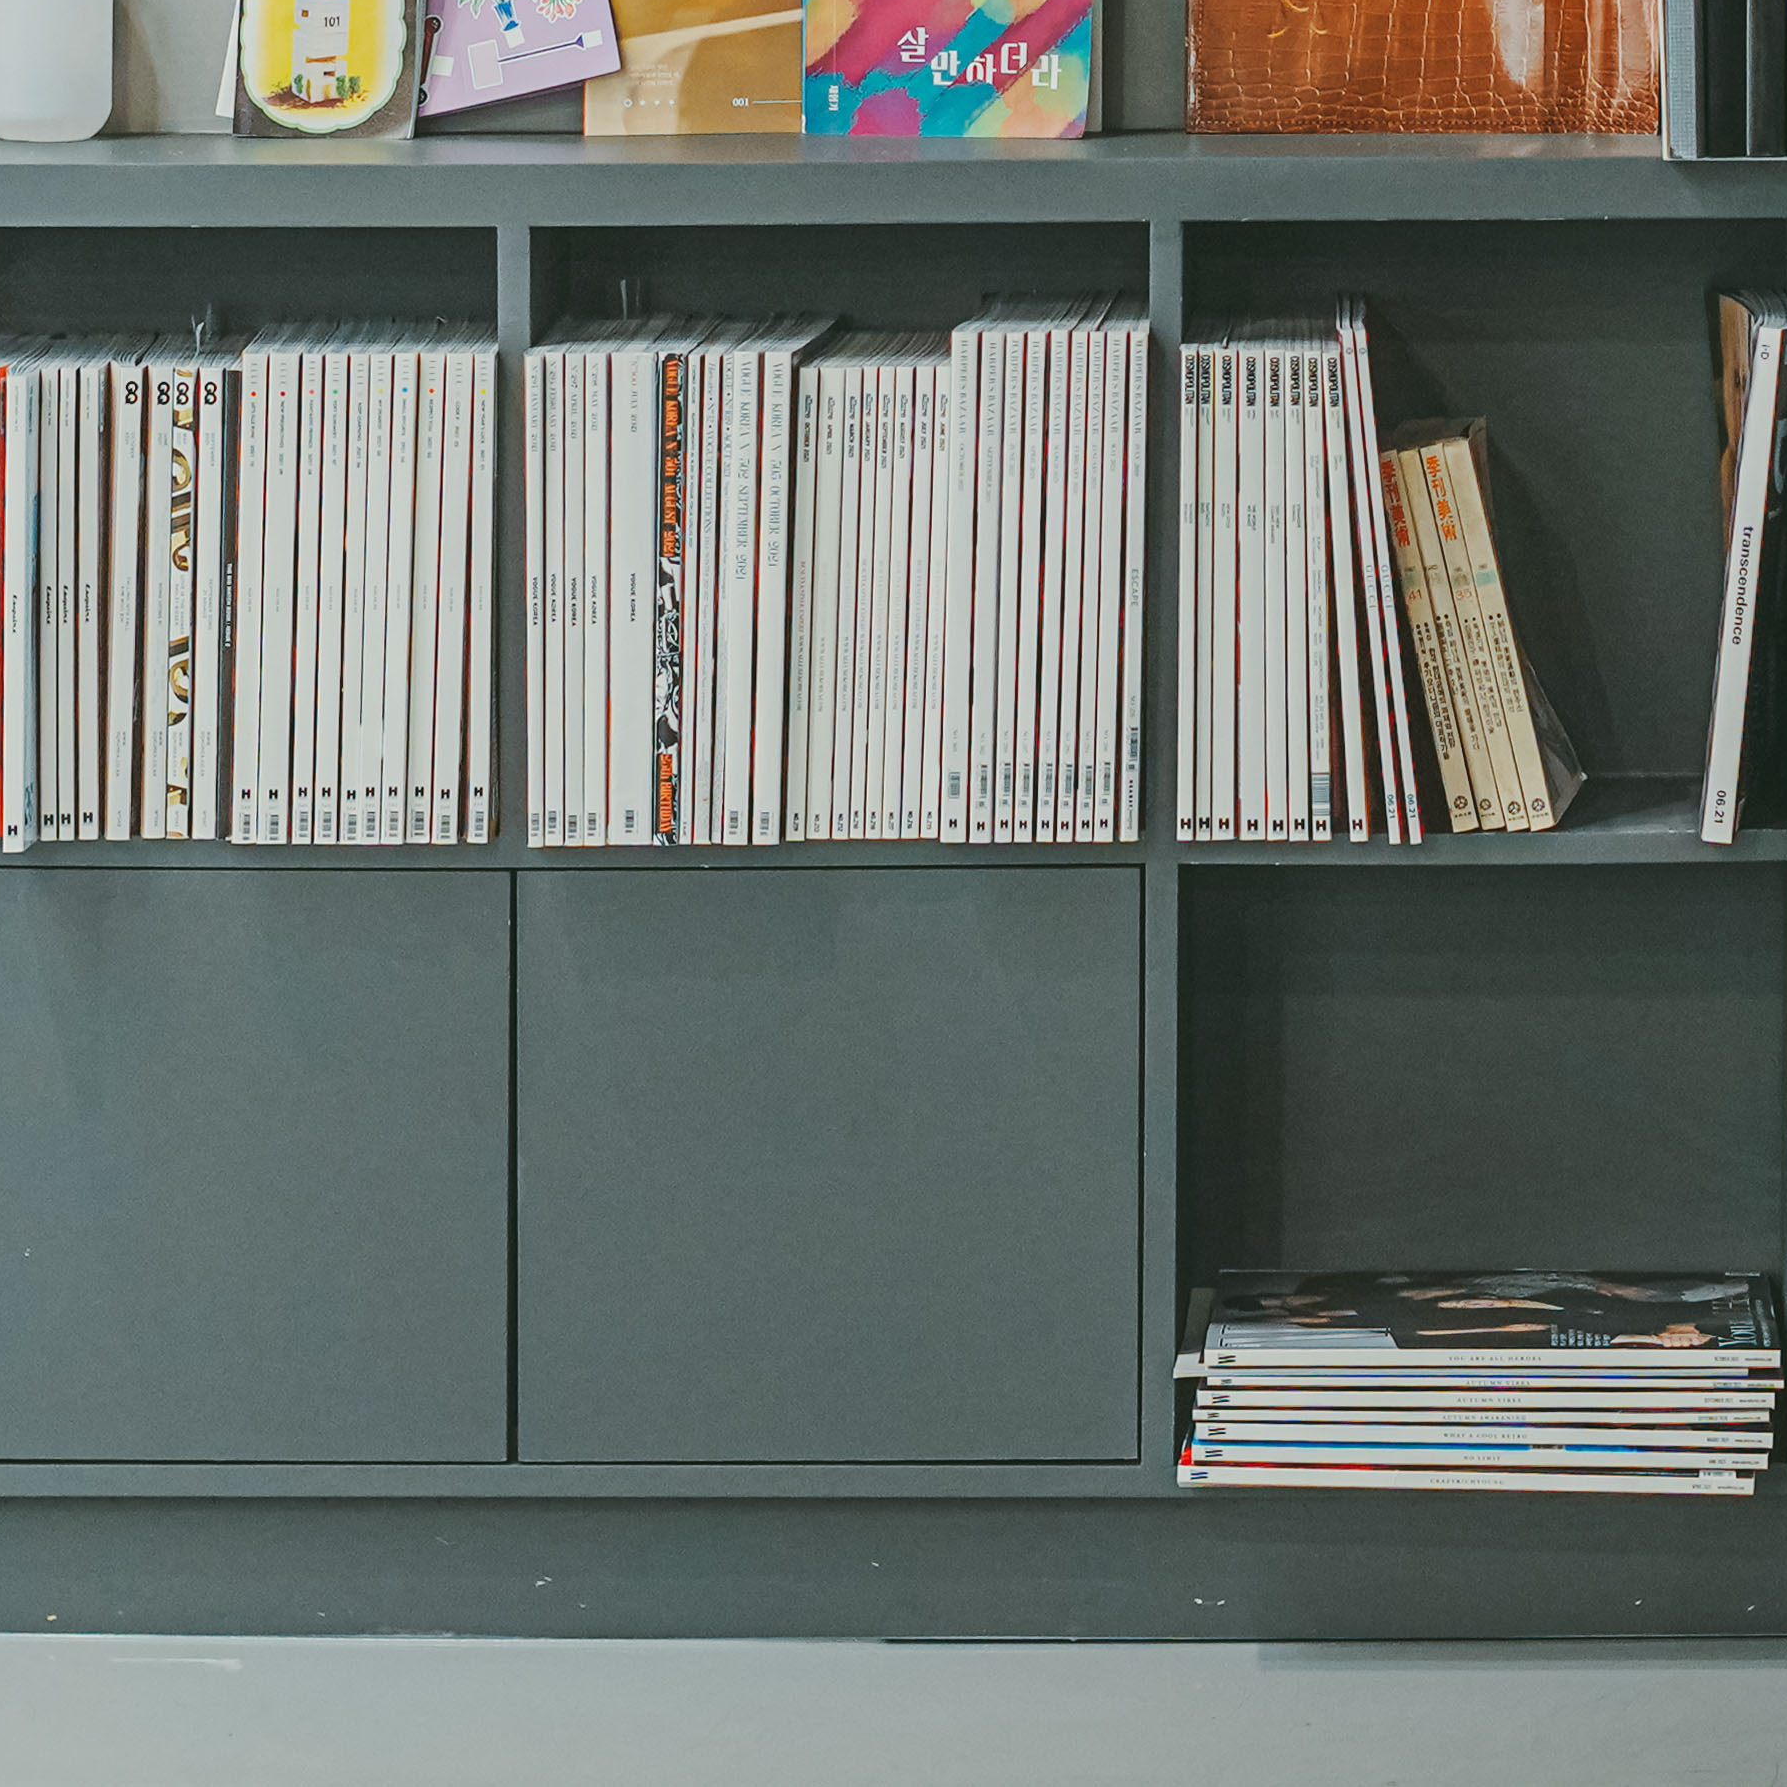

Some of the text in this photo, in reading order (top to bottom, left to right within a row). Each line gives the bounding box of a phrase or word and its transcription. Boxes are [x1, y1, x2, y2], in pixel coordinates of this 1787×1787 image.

[324, 16, 341, 28] 101
[732, 97, 749, 107] 001
[125, 380, 139, 405] GQ
[157, 381, 171, 406] GQ
[176, 381, 190, 405] GQ
[204, 381, 218, 406] GQ
[664, 359, 678, 395] VOGUE
[740, 361, 752, 397] VOGUE
[773, 362, 784, 398] VOGUE
[1185, 355, 1195, 405] COSMOPOLITAN
[1201, 355, 1211, 405] COSMOPOLITAN
[1222, 355, 1231, 405] COSMOPOLITAN
[1246, 357, 1256, 407] COSMOPOLITAN
[1270, 357, 1280, 407] COSMOPOLITAN
[1290, 356, 1301, 406] COSMOPOLITAN
[1309, 357, 1319, 407] COSMOPOLITAN
[1328, 357, 1340, 407] COSMOPOLITAN
[664, 400, 678, 436] KOREA
[739, 401, 751, 437] KOREA
[772, 403, 783, 439] KOREA
[663, 483, 677, 524] AUGUST
[1131, 569, 1139, 607] ESCAPE
[1365, 564, 1377, 610] GUCCI
[1381, 564, 1393, 611] GUCCI
[1409, 589, 1423, 603] 41
[1731, 525, 1756, 646] transcendence
[659, 780, 673, 833] BIRTHDAY
[1387, 794, 1396, 819] 06.21
[1407, 794, 1417, 819] 06.21
[1713, 789, 1727, 825] 06.21
